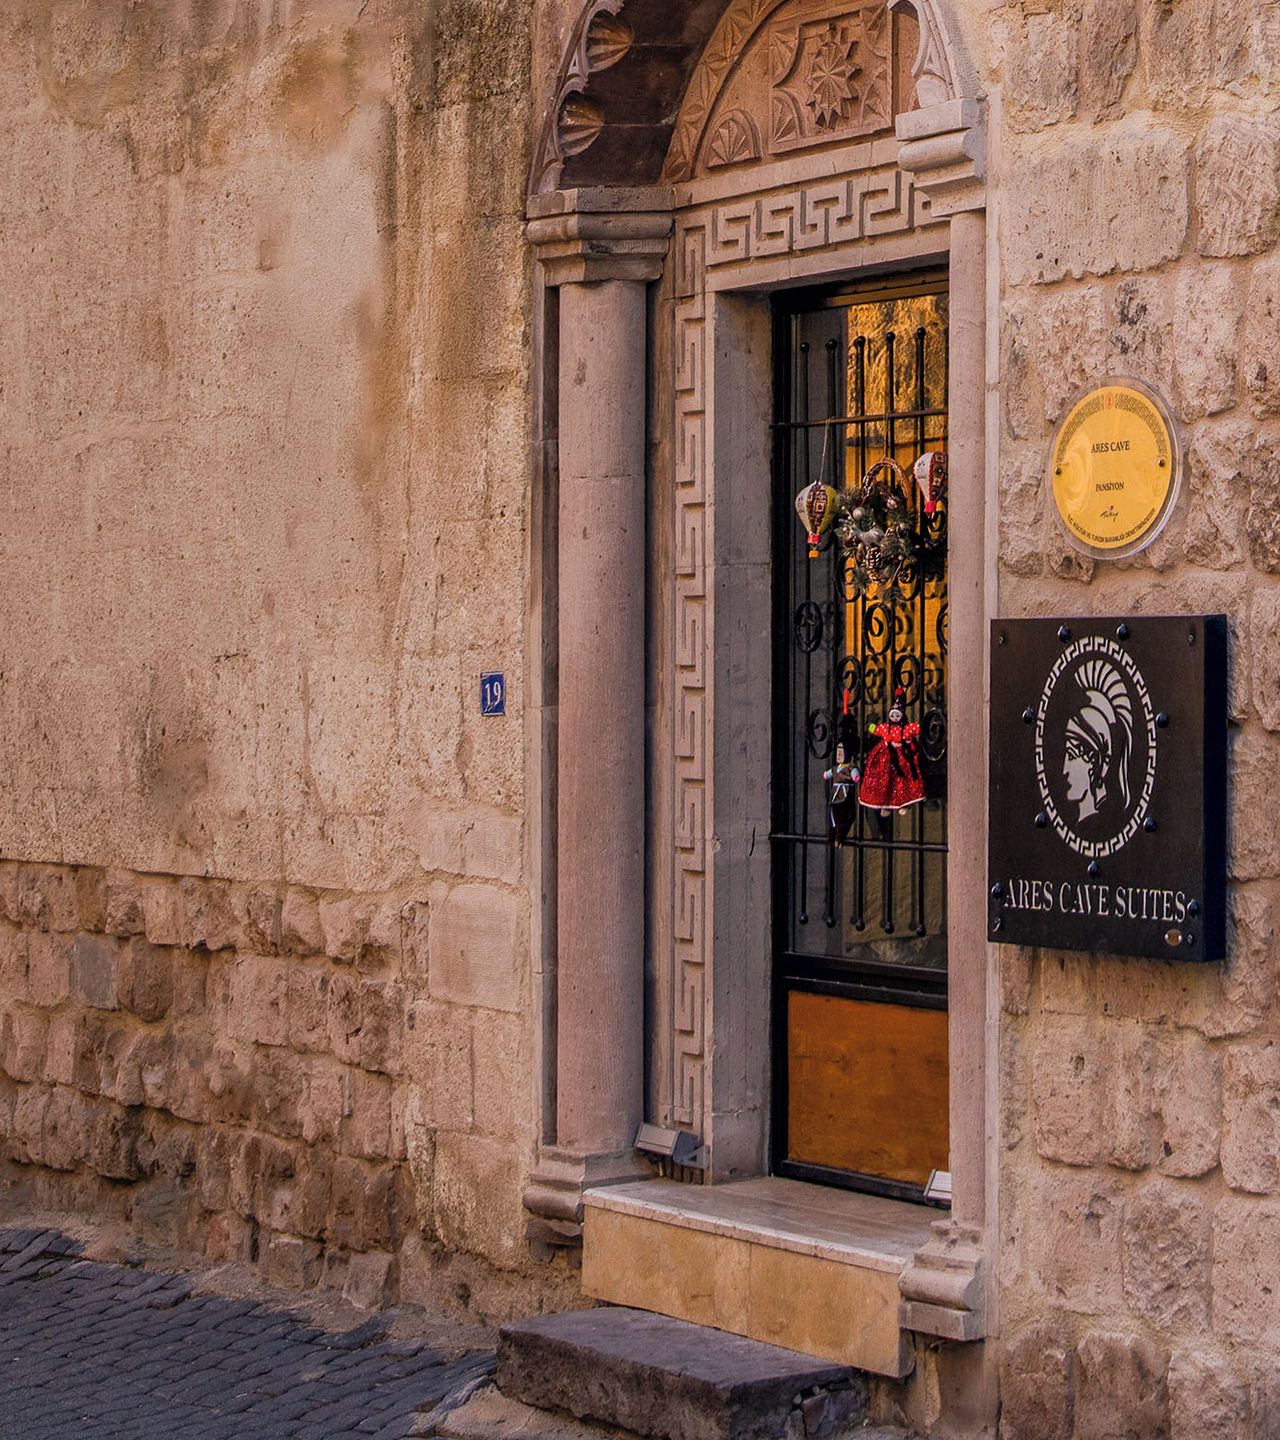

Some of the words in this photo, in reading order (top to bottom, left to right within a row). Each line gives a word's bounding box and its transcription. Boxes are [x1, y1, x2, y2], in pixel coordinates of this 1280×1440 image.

[1091, 442, 1109, 453] ARES
[1110, 440, 1130, 451] CAVE
[484, 681, 502, 707] 19
[1004, 879, 1054, 912] ARES
[1059, 881, 1109, 916] CAVE
[1115, 885, 1187, 923] SUITES
